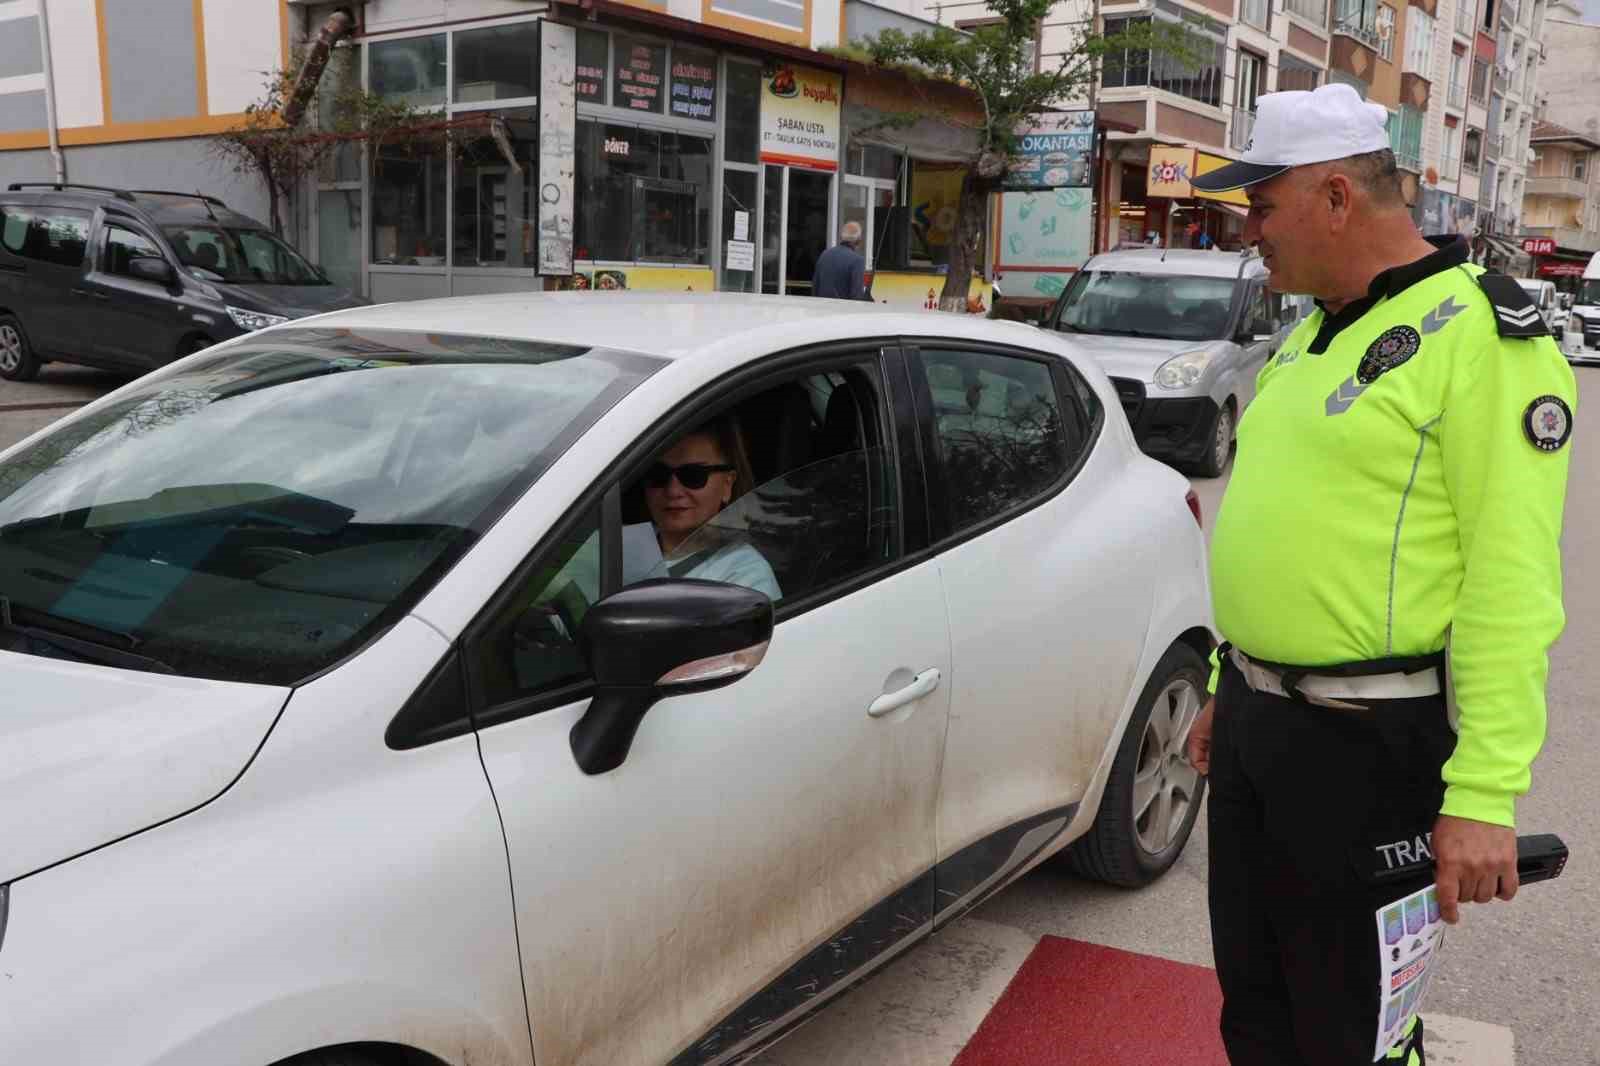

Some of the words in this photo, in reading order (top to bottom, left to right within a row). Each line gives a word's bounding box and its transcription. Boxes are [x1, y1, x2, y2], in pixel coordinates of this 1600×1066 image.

[777, 117, 804, 131] ŞABAN
[806, 121, 825, 136] USTA
[604, 136, 629, 155] DÖNER
[1152, 160, 1188, 184] ŞOK
